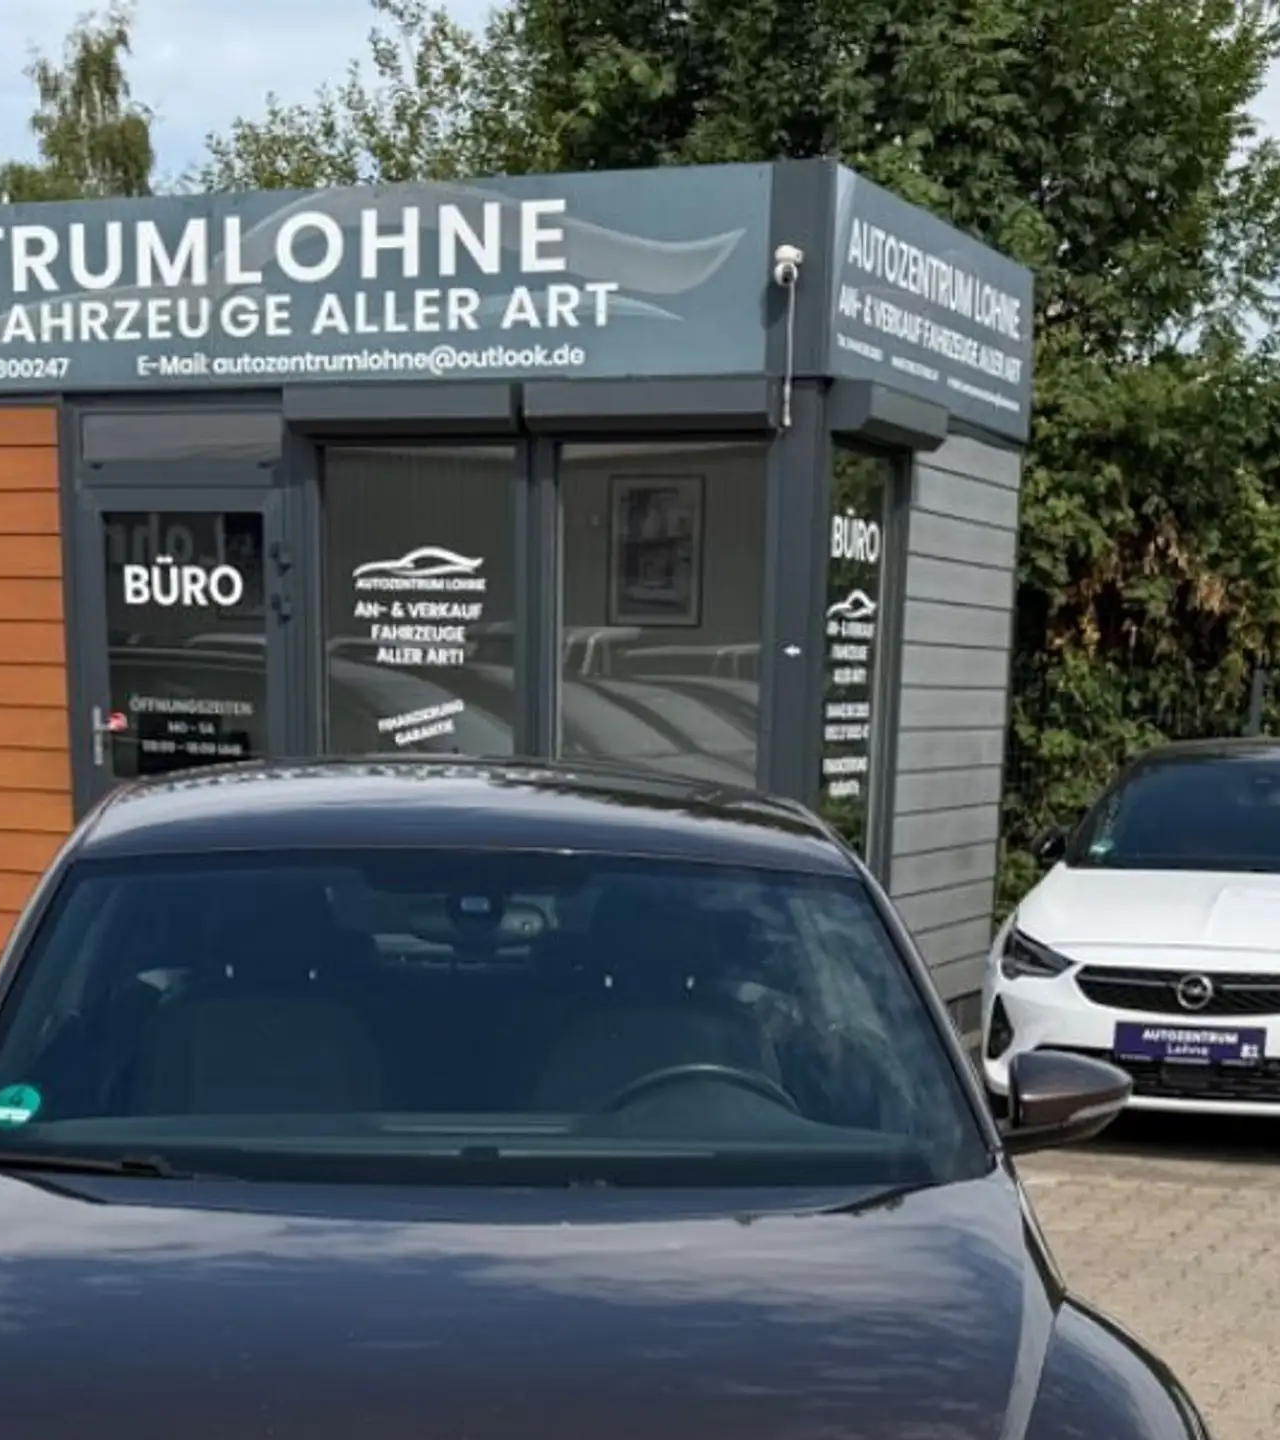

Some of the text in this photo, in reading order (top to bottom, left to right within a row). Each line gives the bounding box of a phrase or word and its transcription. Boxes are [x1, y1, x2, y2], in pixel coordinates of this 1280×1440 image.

[847, 216, 1021, 341] AUTOZENTRUM LOHNE
[311, 287, 479, 336] ALLER
[501, 281, 620, 330] ART
[137, 342, 586, 376] E-Mail: autozentrumlohne@outlook.de
[831, 506, 881, 565] BÜRO
[123, 554, 243, 606] BÜRO
[354, 600, 483, 620] AN- & VERKAUF
[371, 623, 467, 642] FAHRZEUGE
[376, 647, 422, 664] ALLER
[1141, 1028, 1239, 1045] AUTOZENTRUM
[1167, 1043, 1210, 1056] Lohne
